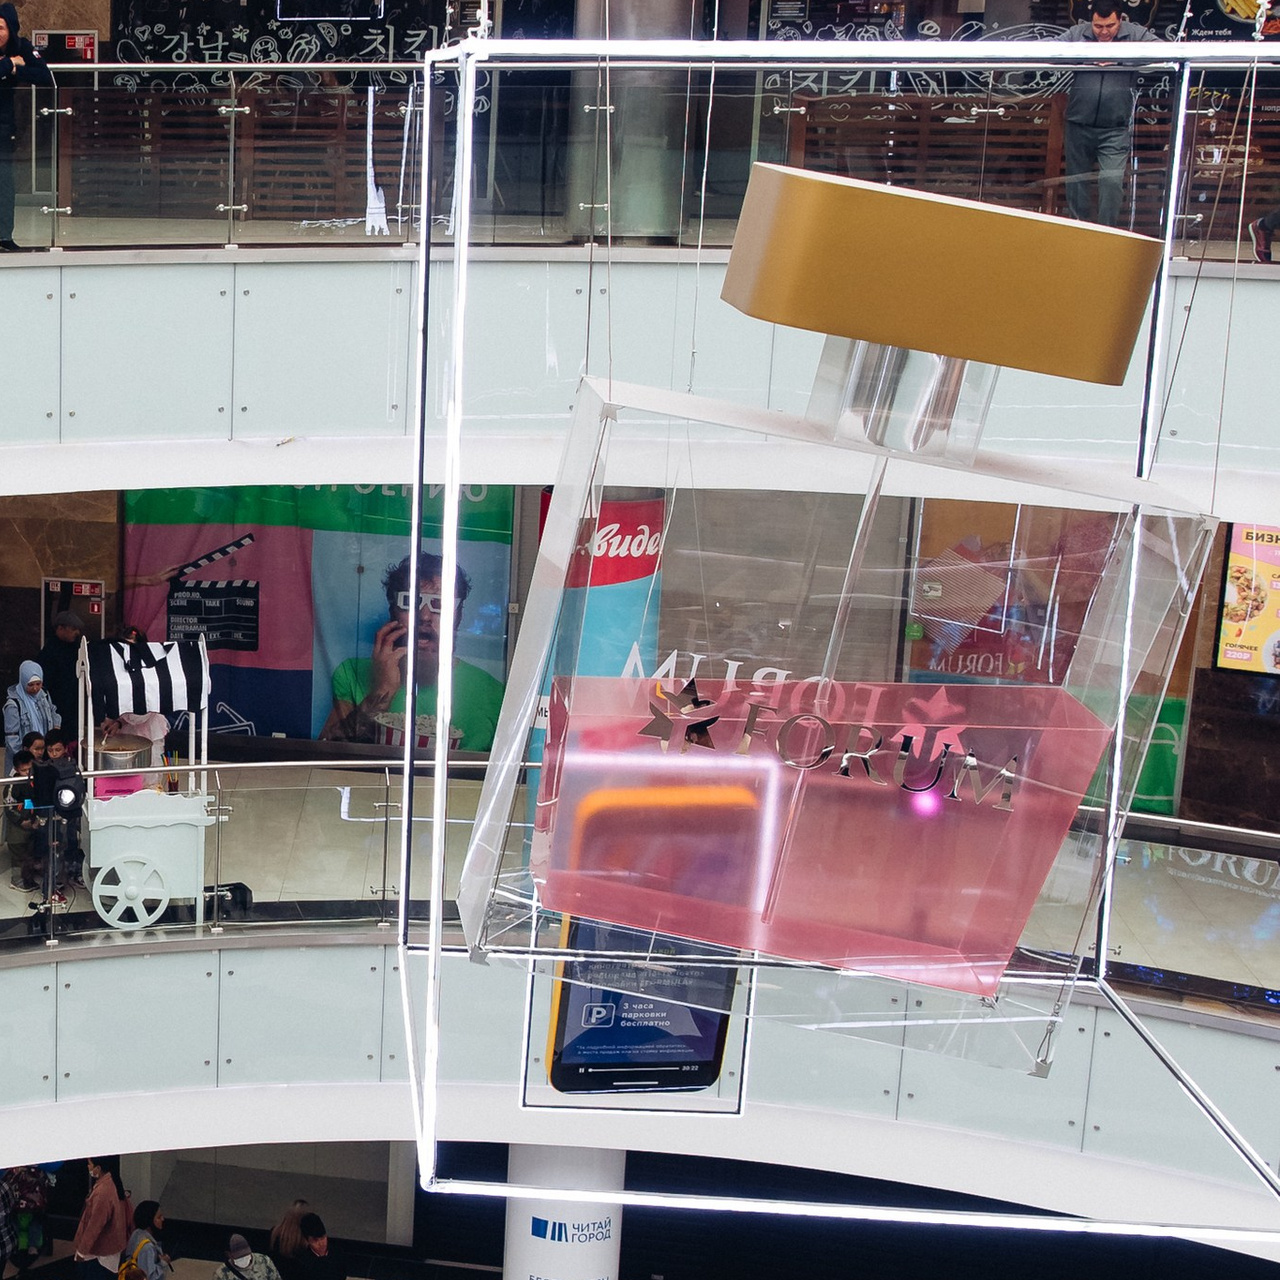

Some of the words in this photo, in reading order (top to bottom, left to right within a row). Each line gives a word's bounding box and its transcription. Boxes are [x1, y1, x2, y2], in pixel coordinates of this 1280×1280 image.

[1191, 28, 1214, 36] Ждем
[170, 616, 198, 624] DIRECTOR
[734, 701, 1018, 813] FORUM
[622, 1011, 667, 1020] парковки
[572, 1217, 612, 1233] ЧИТАЙ
[571, 1230, 612, 1243] ГОРОД
